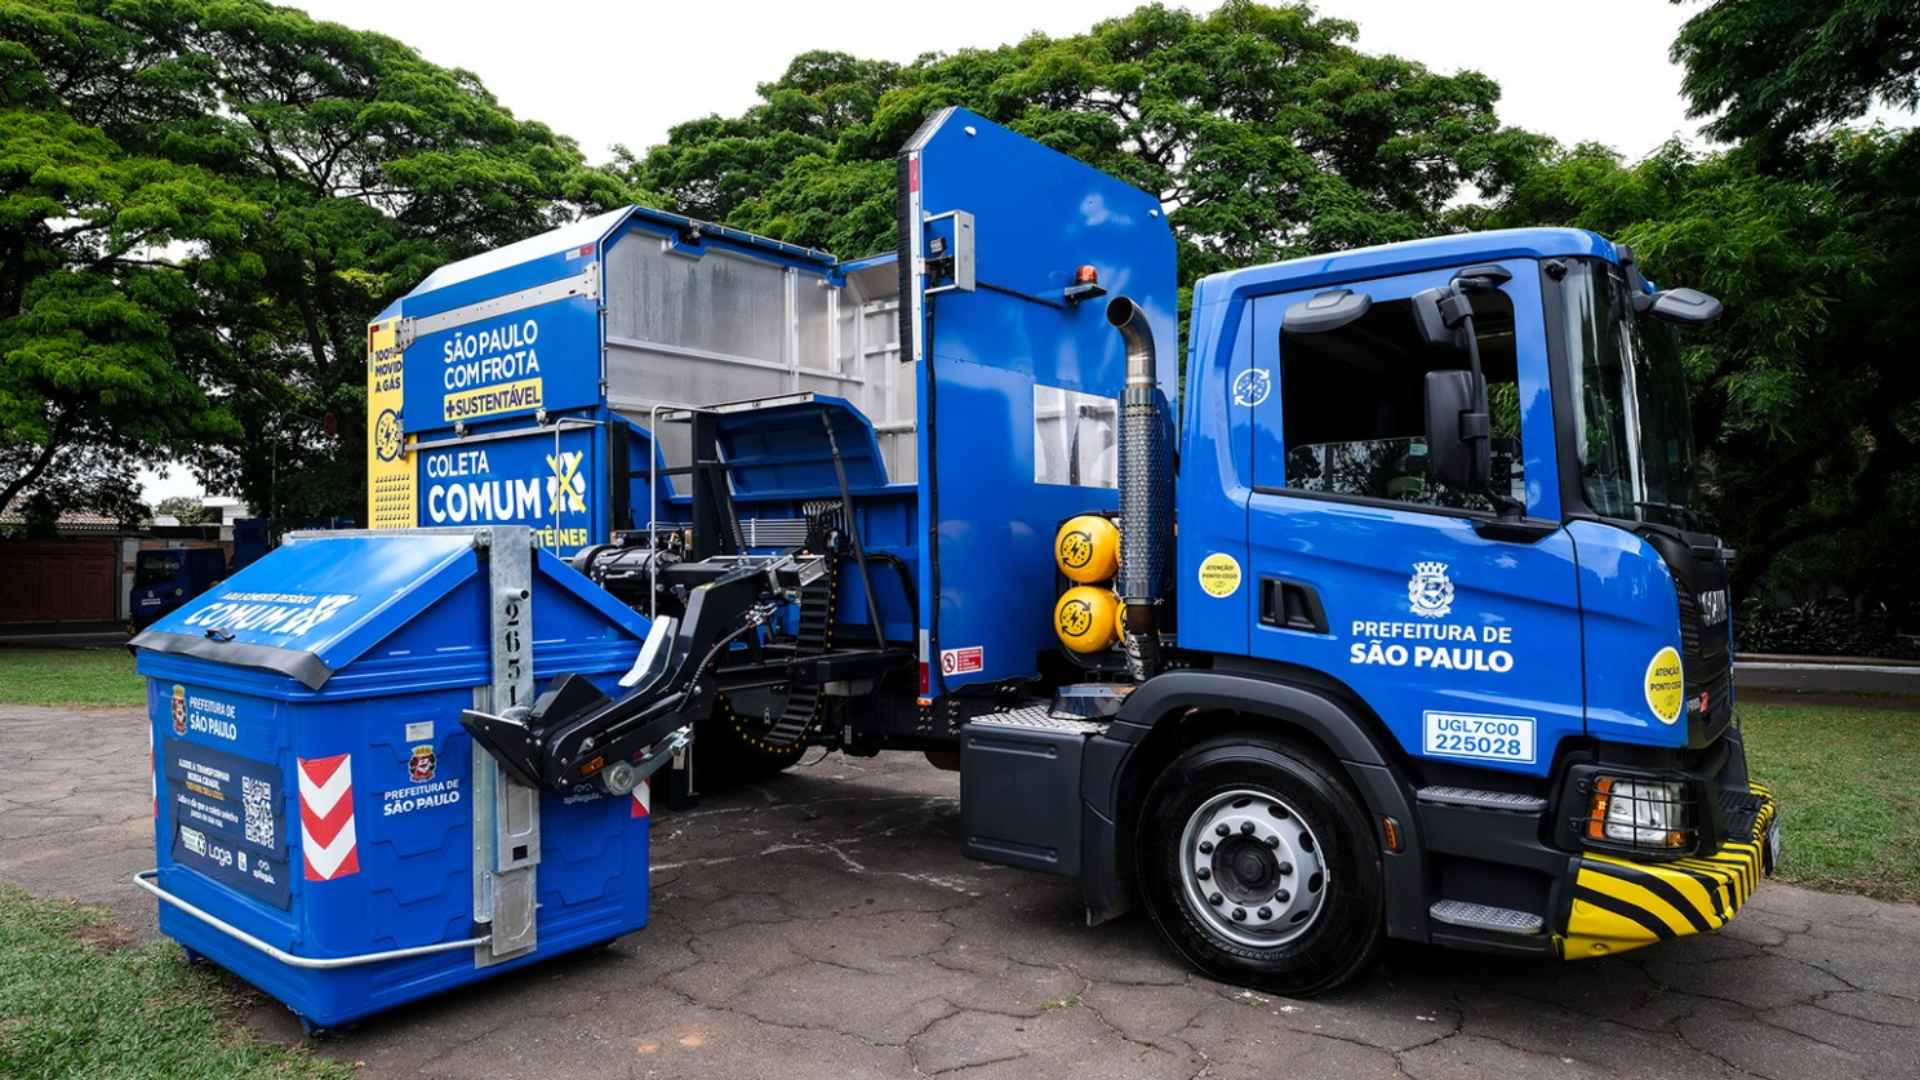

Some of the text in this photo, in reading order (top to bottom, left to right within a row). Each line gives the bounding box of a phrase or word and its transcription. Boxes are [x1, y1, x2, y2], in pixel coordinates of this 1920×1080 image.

[443, 319, 538, 363] SÃO PAULO
[443, 348, 540, 390] COM FROTA
[375, 375, 401, 393] A GÁS
[427, 450, 490, 478] COLETA
[428, 477, 542, 523] COMUM
[183, 602, 300, 633] COMUM
[1352, 620, 1513, 644] PREFEITURA DE
[1349, 639, 1514, 673] SÃO PAULO
[189, 696, 236, 719] PREFEITURA DE
[190, 711, 237, 741] SÃO PAULO
[1437, 718, 1519, 737] UGL7C00
[1435, 734, 1521, 756] 225028
[383, 790, 460, 817] SÃO PAULO
[384, 779, 459, 801] PREFEITURA DE
